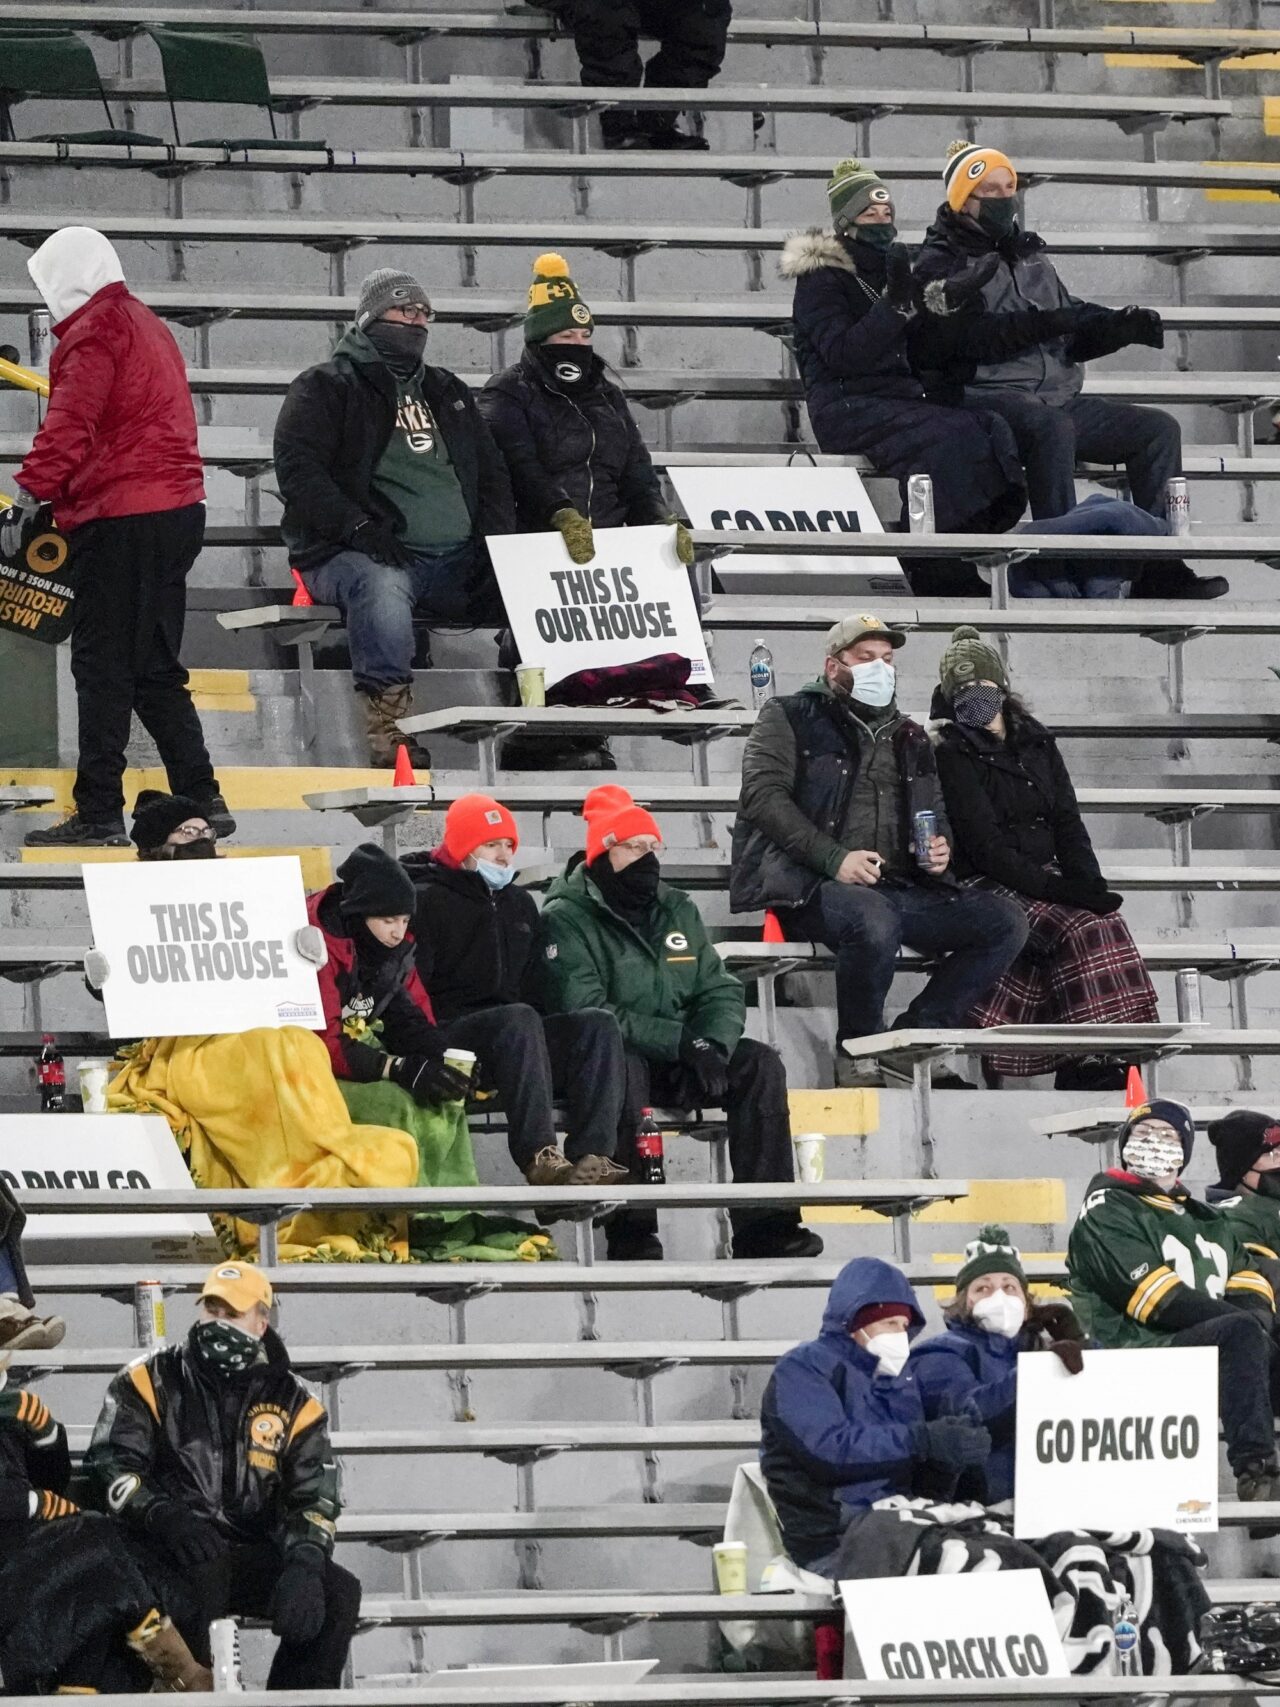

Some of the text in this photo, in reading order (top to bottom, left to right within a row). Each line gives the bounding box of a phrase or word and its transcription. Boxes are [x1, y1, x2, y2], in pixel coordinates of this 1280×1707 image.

[26, 573, 53, 591] NOSE
[549, 566, 639, 605] THIS IS
[535, 602, 677, 643] OUR HOUSE
[149, 901, 249, 942] THIS IS
[126, 940, 288, 984] OUR HOUSE
[1036, 1415, 1199, 1464] GO PACK GO
[880, 1633, 1049, 1680] GO PACK GO
